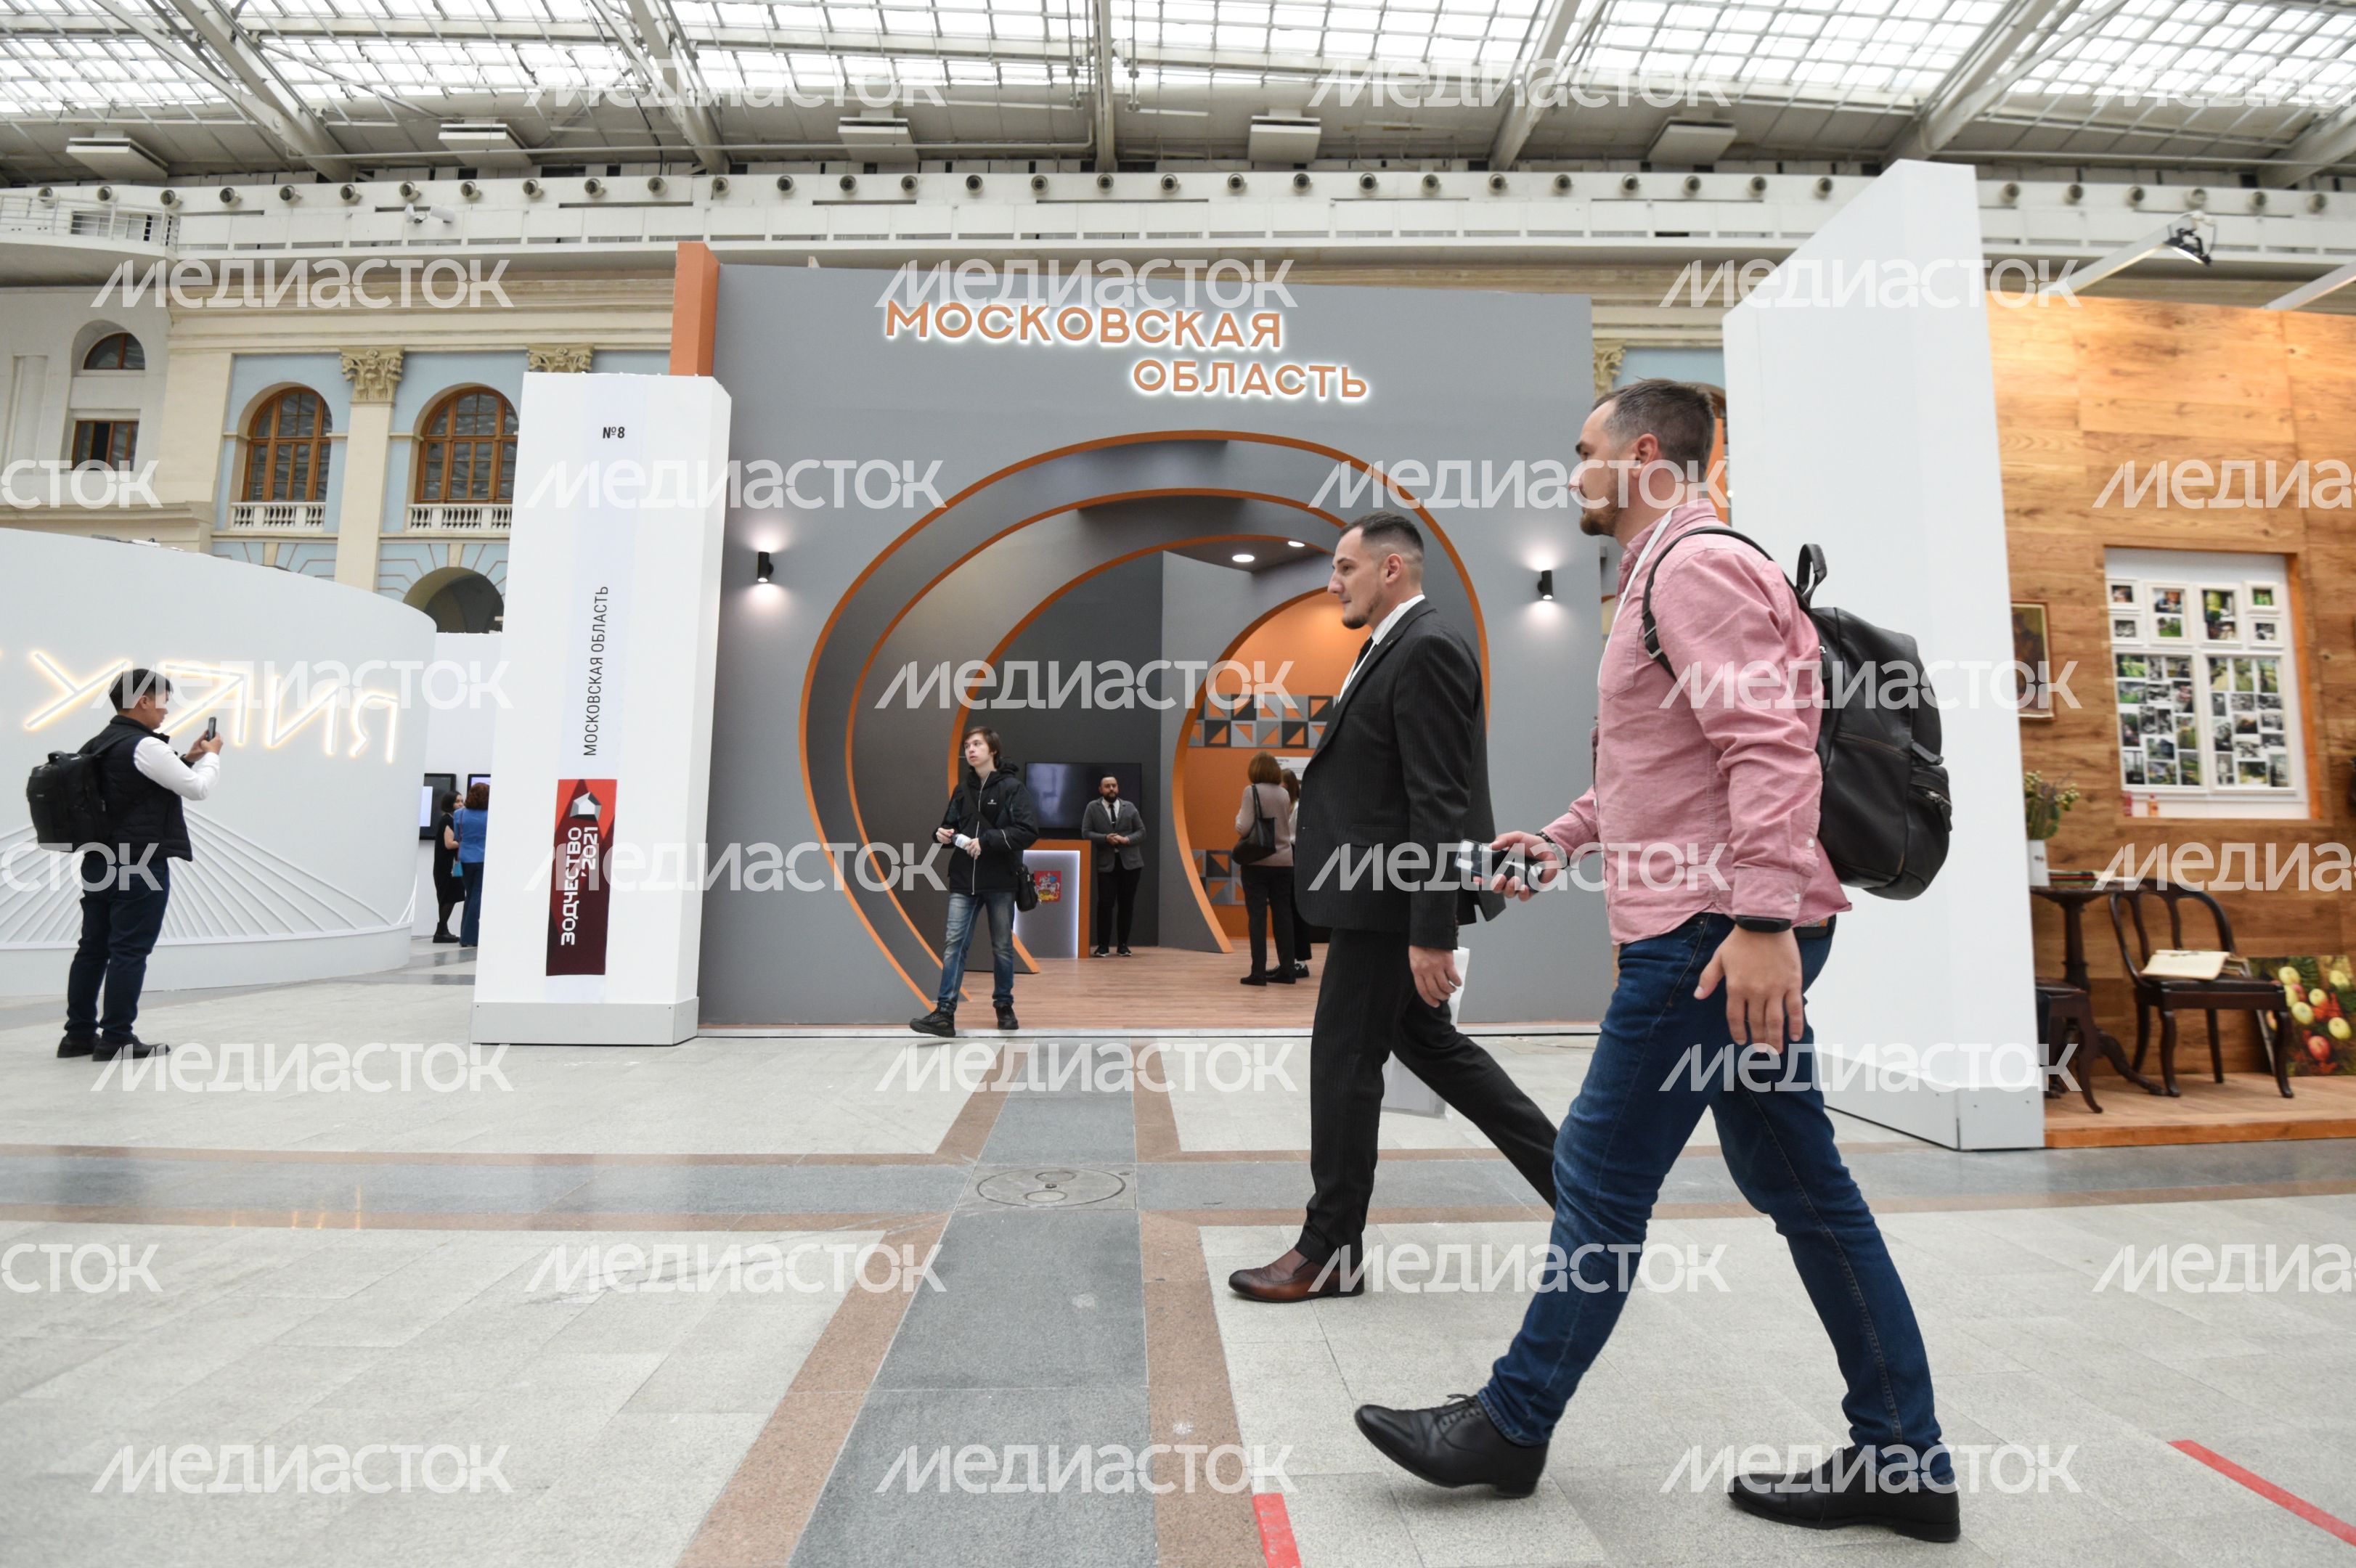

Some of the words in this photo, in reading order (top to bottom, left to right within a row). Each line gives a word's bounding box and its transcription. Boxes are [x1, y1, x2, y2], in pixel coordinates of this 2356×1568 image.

[886, 301, 1281, 347] МОСКОВСКАЯ
[1133, 359, 1366, 398] ОБЛАСТЬ
[591, 585, 608, 652] ОБЛАСТЬ
[583, 656, 603, 755] МОСКОВСКАЯ
[561, 827, 582, 946] ЗОДЧЕСТВО
